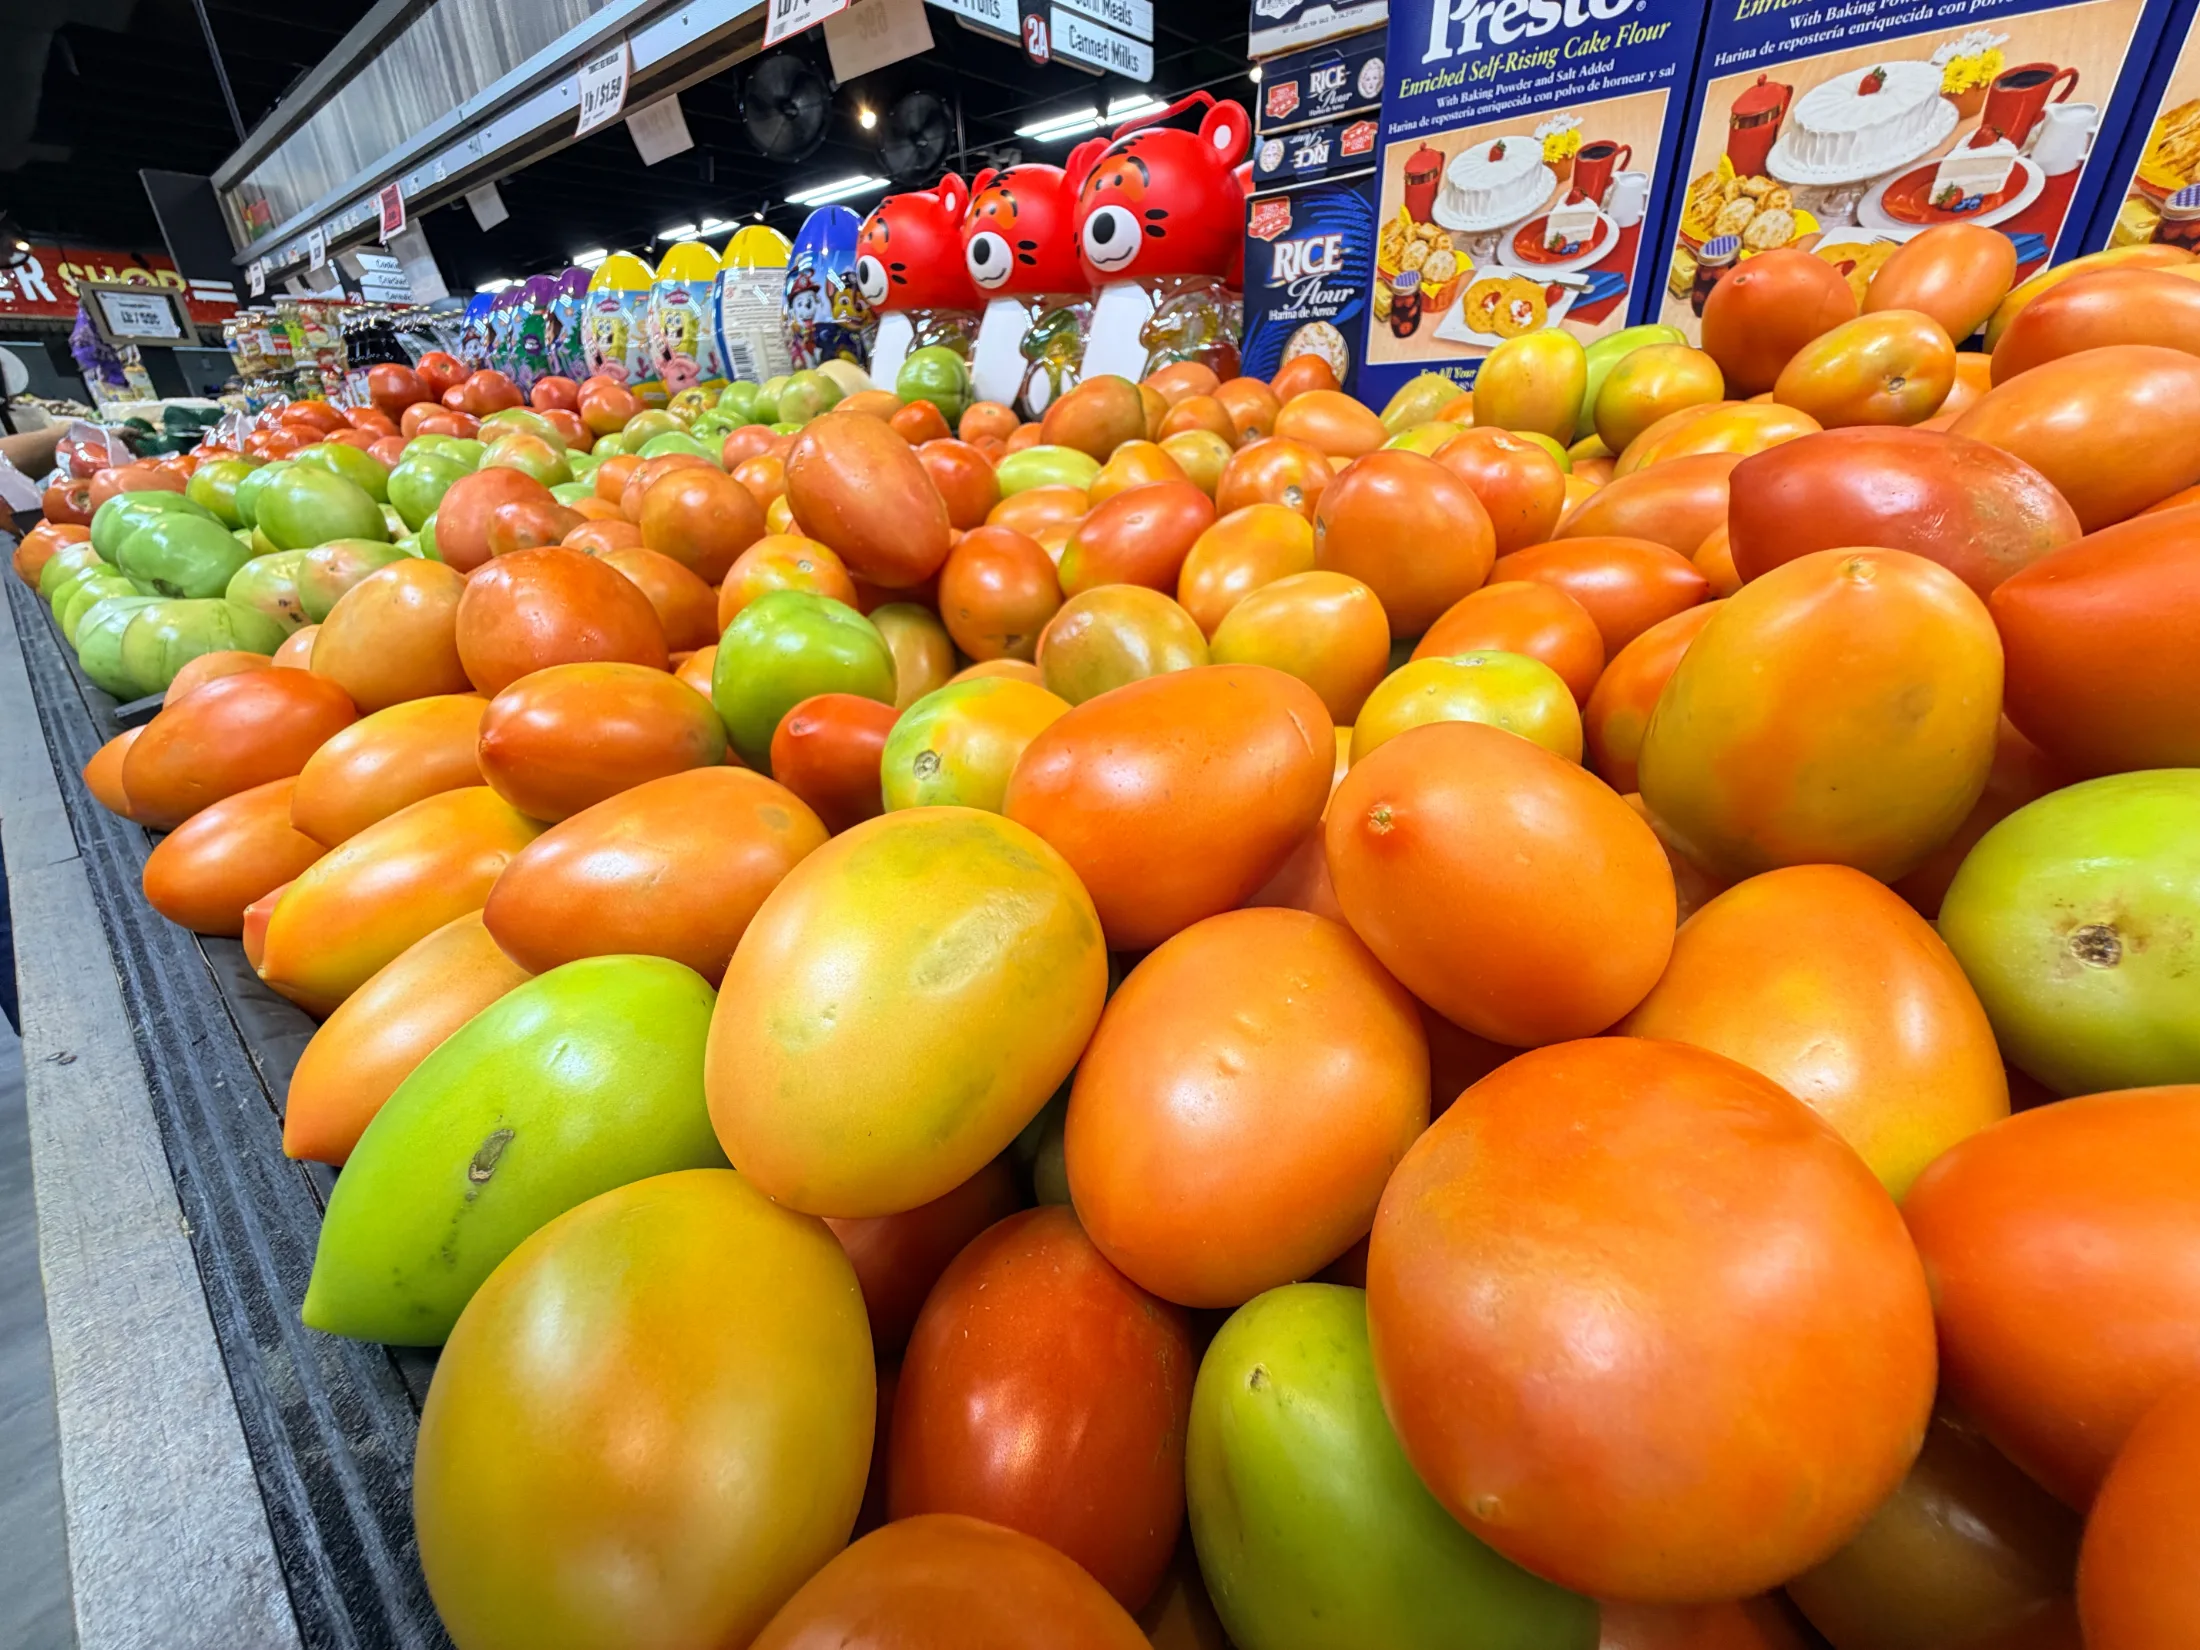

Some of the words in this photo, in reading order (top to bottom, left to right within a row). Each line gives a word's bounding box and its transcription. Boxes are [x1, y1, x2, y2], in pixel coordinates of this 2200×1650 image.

[964, 0, 1000, 19] ruits
[1076, 0, 1100, 13] rn
[1101, 0, 1134, 27] Meals
[1733, 0, 1814, 21] Enric
[1790, 10, 1822, 30] With
[1825, 1, 1876, 22] Baking
[1028, 18, 1049, 59] 2A
[1069, 25, 1108, 61] Canned
[1111, 41, 1139, 72] Milks
[1714, 47, 1756, 67] Harina
[1760, 40, 1775, 56] de
[1778, 25, 1844, 52] repostería
[1848, 5, 1933, 34] enriquecida
[1937, 1, 1966, 16] con
[1398, 62, 1468, 99] Enriched
[1468, 44, 1560, 82] Self-Rising
[1563, 30, 1612, 59] Cake
[1613, 20, 1672, 49] Flour
[1309, 64, 1347, 93] RICE
[1437, 94, 1459, 108] With
[1460, 87, 1494, 103] Baking
[1495, 78, 1533, 95] Powder
[1534, 72, 1554, 87] and
[1556, 67, 1576, 82] Salt
[1578, 58, 1615, 77] Added
[1388, 120, 1418, 135] Harina
[1418, 116, 1432, 127] de
[1477, 93, 1532, 115] enriquecida
[1534, 92, 1553, 103] con
[1554, 84, 1585, 101] polvo
[1587, 79, 1600, 92] de
[1602, 71, 1647, 89] hornear
[1648, 70, 1657, 83] y
[1658, 62, 1676, 77] sal
[1293, 144, 1330, 169] RICE
[1271, 233, 1344, 284] RICE
[1268, 308, 1297, 321] Harina
[1298, 307, 1310, 319] de
[1311, 306, 1338, 317] Arroz
[1454, 366, 1477, 379] Your
